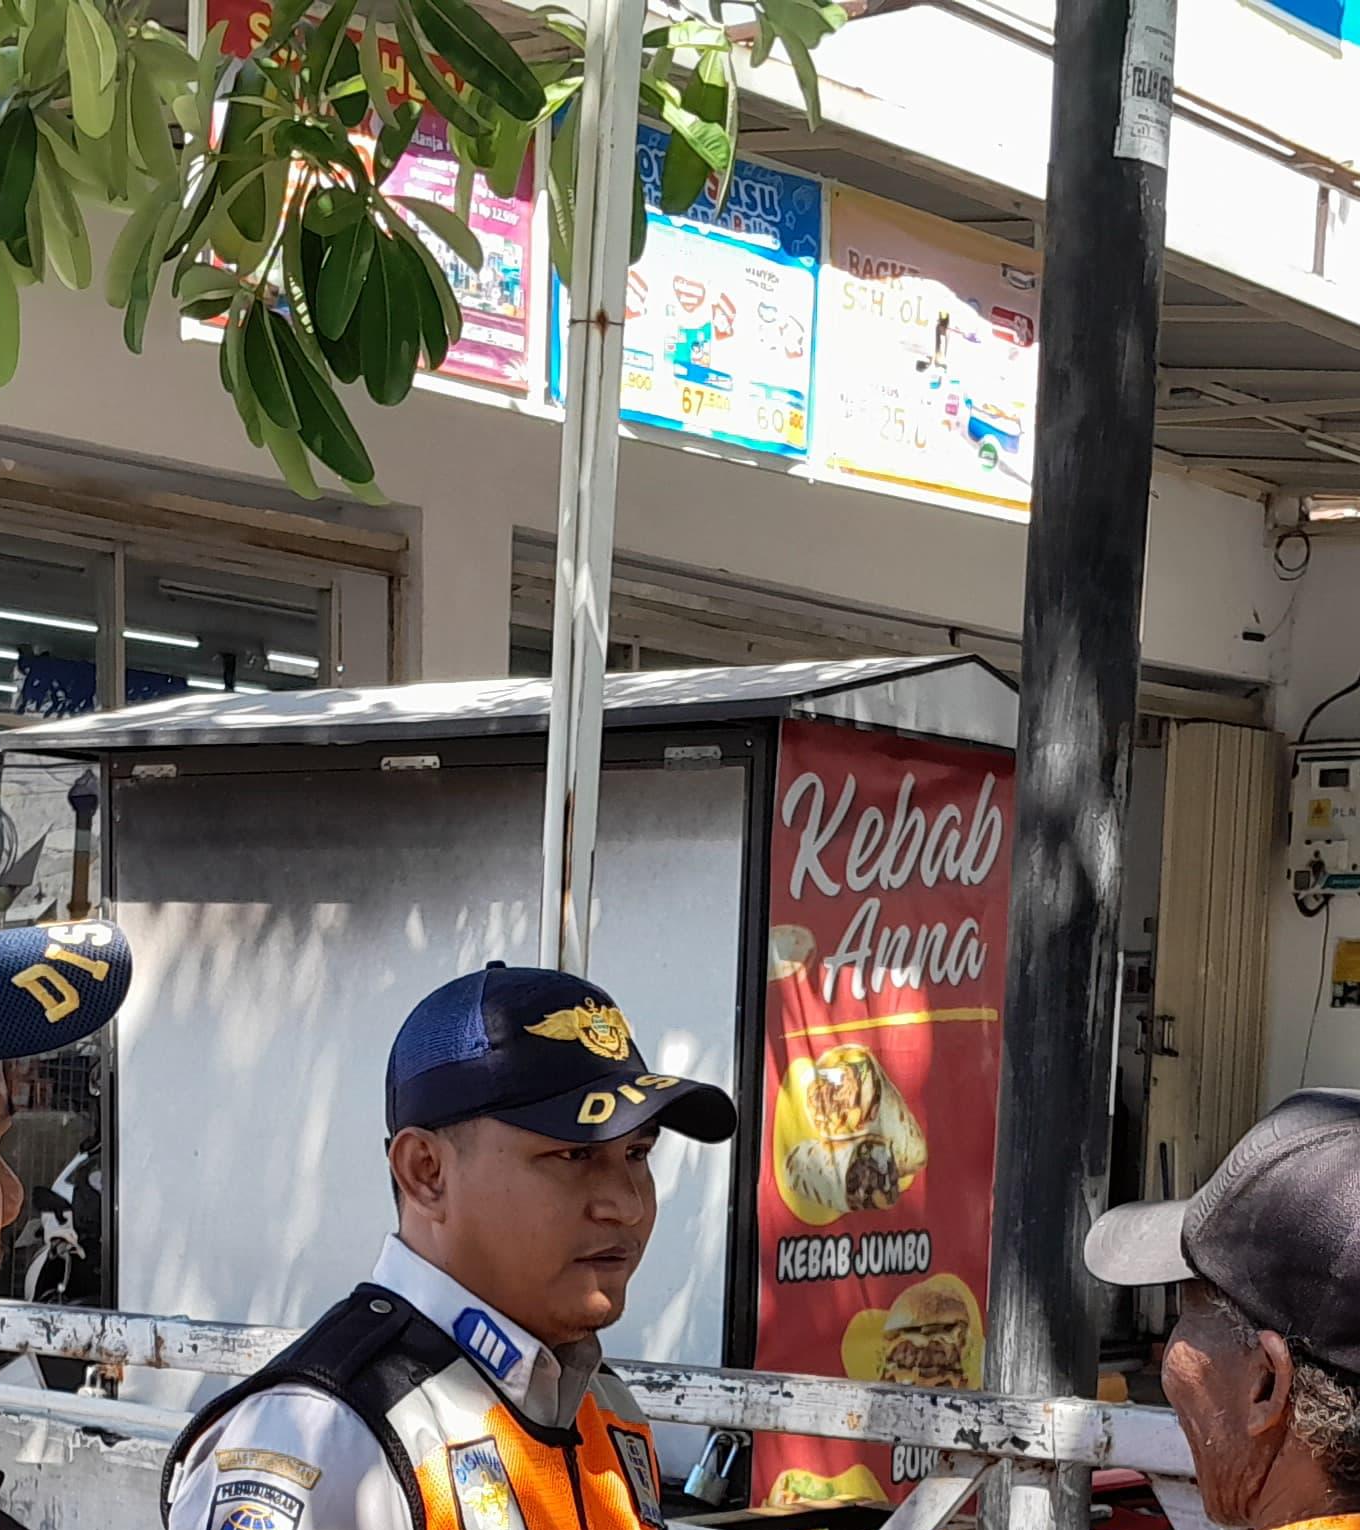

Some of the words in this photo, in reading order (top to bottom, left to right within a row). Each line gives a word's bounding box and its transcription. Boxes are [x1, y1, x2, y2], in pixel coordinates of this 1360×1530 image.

[842, 280, 929, 328] SHOL
[682, 387, 705, 416] 67
[782, 772, 1004, 900] Kebab
[822, 897, 988, 1004] Anna
[778, 1237, 852, 1282] KEBAB
[855, 1231, 930, 1273] JUMBO
